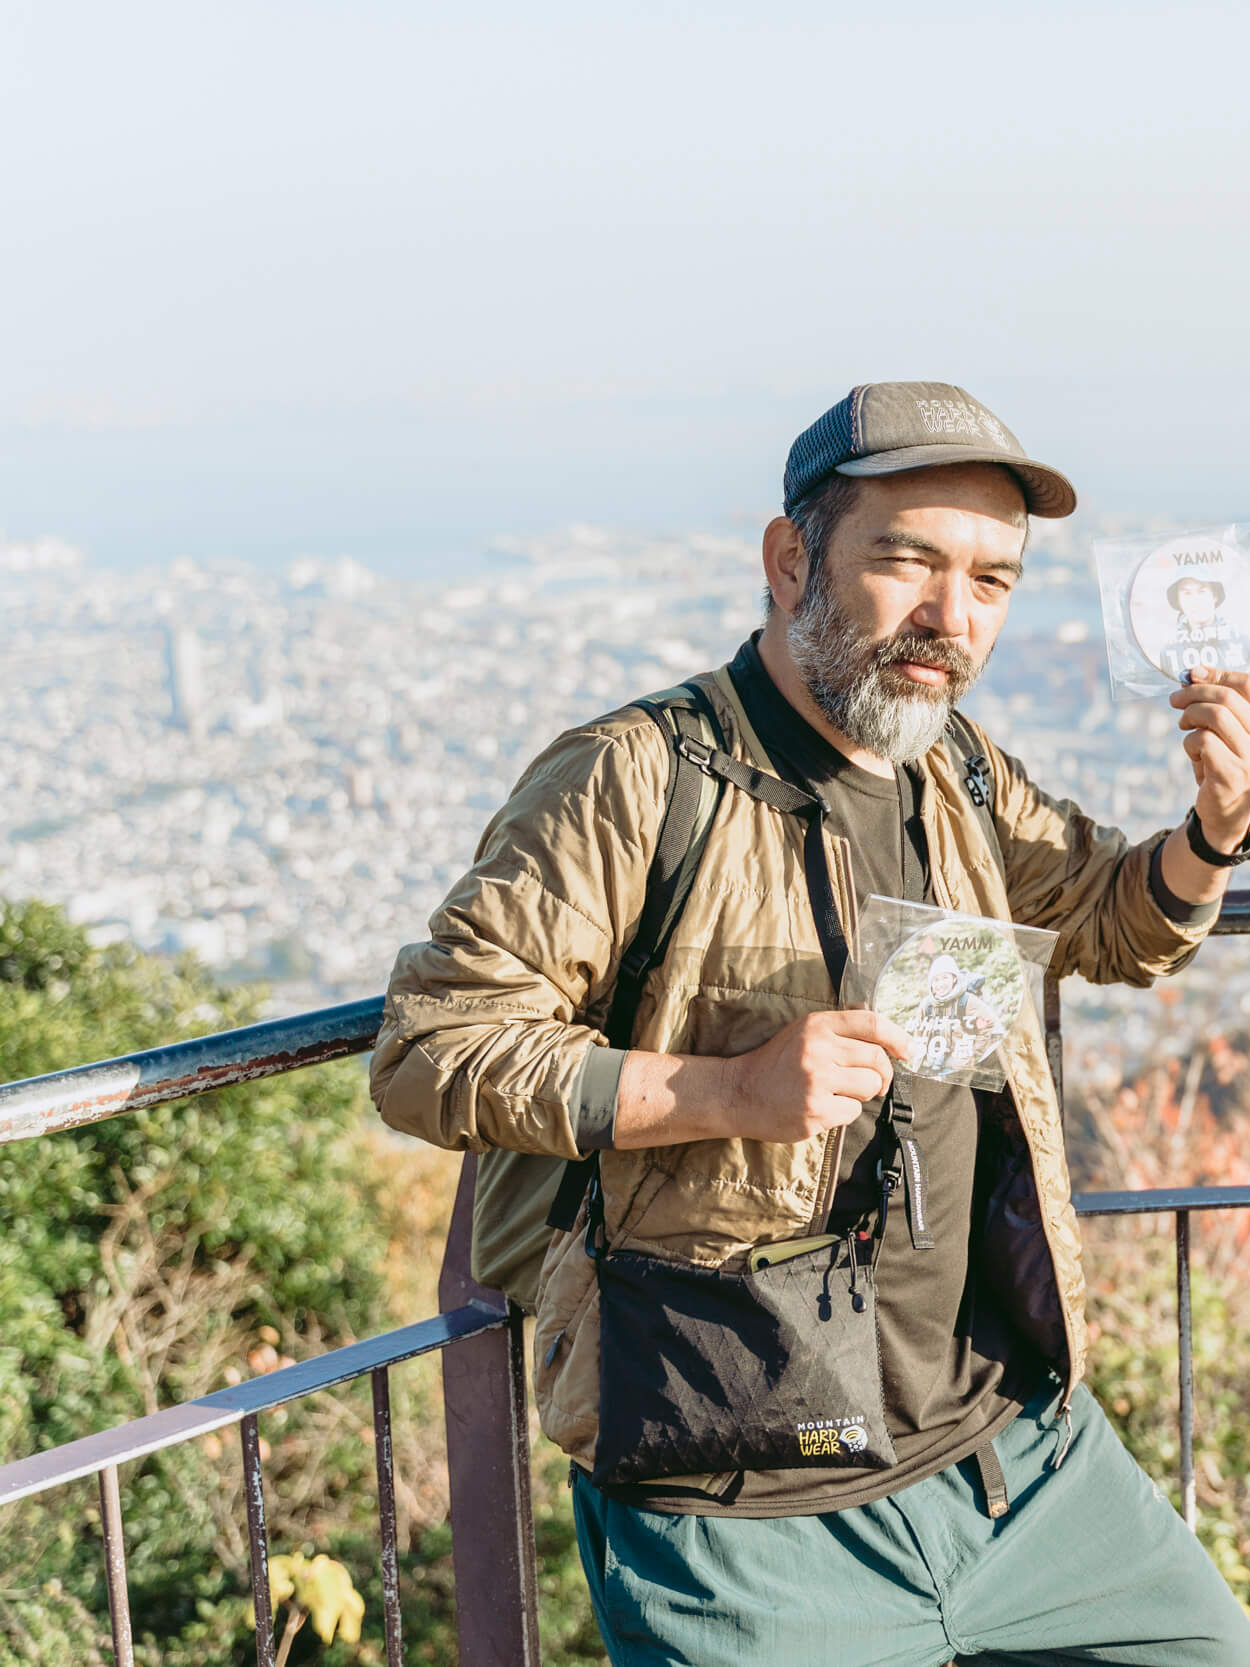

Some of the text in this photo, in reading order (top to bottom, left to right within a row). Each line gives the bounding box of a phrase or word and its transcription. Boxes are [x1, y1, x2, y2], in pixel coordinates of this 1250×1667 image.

[920, 407, 975, 425] HARD
[922, 420, 983, 438] WEAR
[1173, 550, 1224, 566] YAMM
[939, 936, 993, 951] YAMM
[907, 1140, 921, 1183] MOUNTAIN
[796, 1415, 865, 1431] MOUNTAIN
[799, 1428, 839, 1445] HARD
[800, 1441, 841, 1457] WEAR
